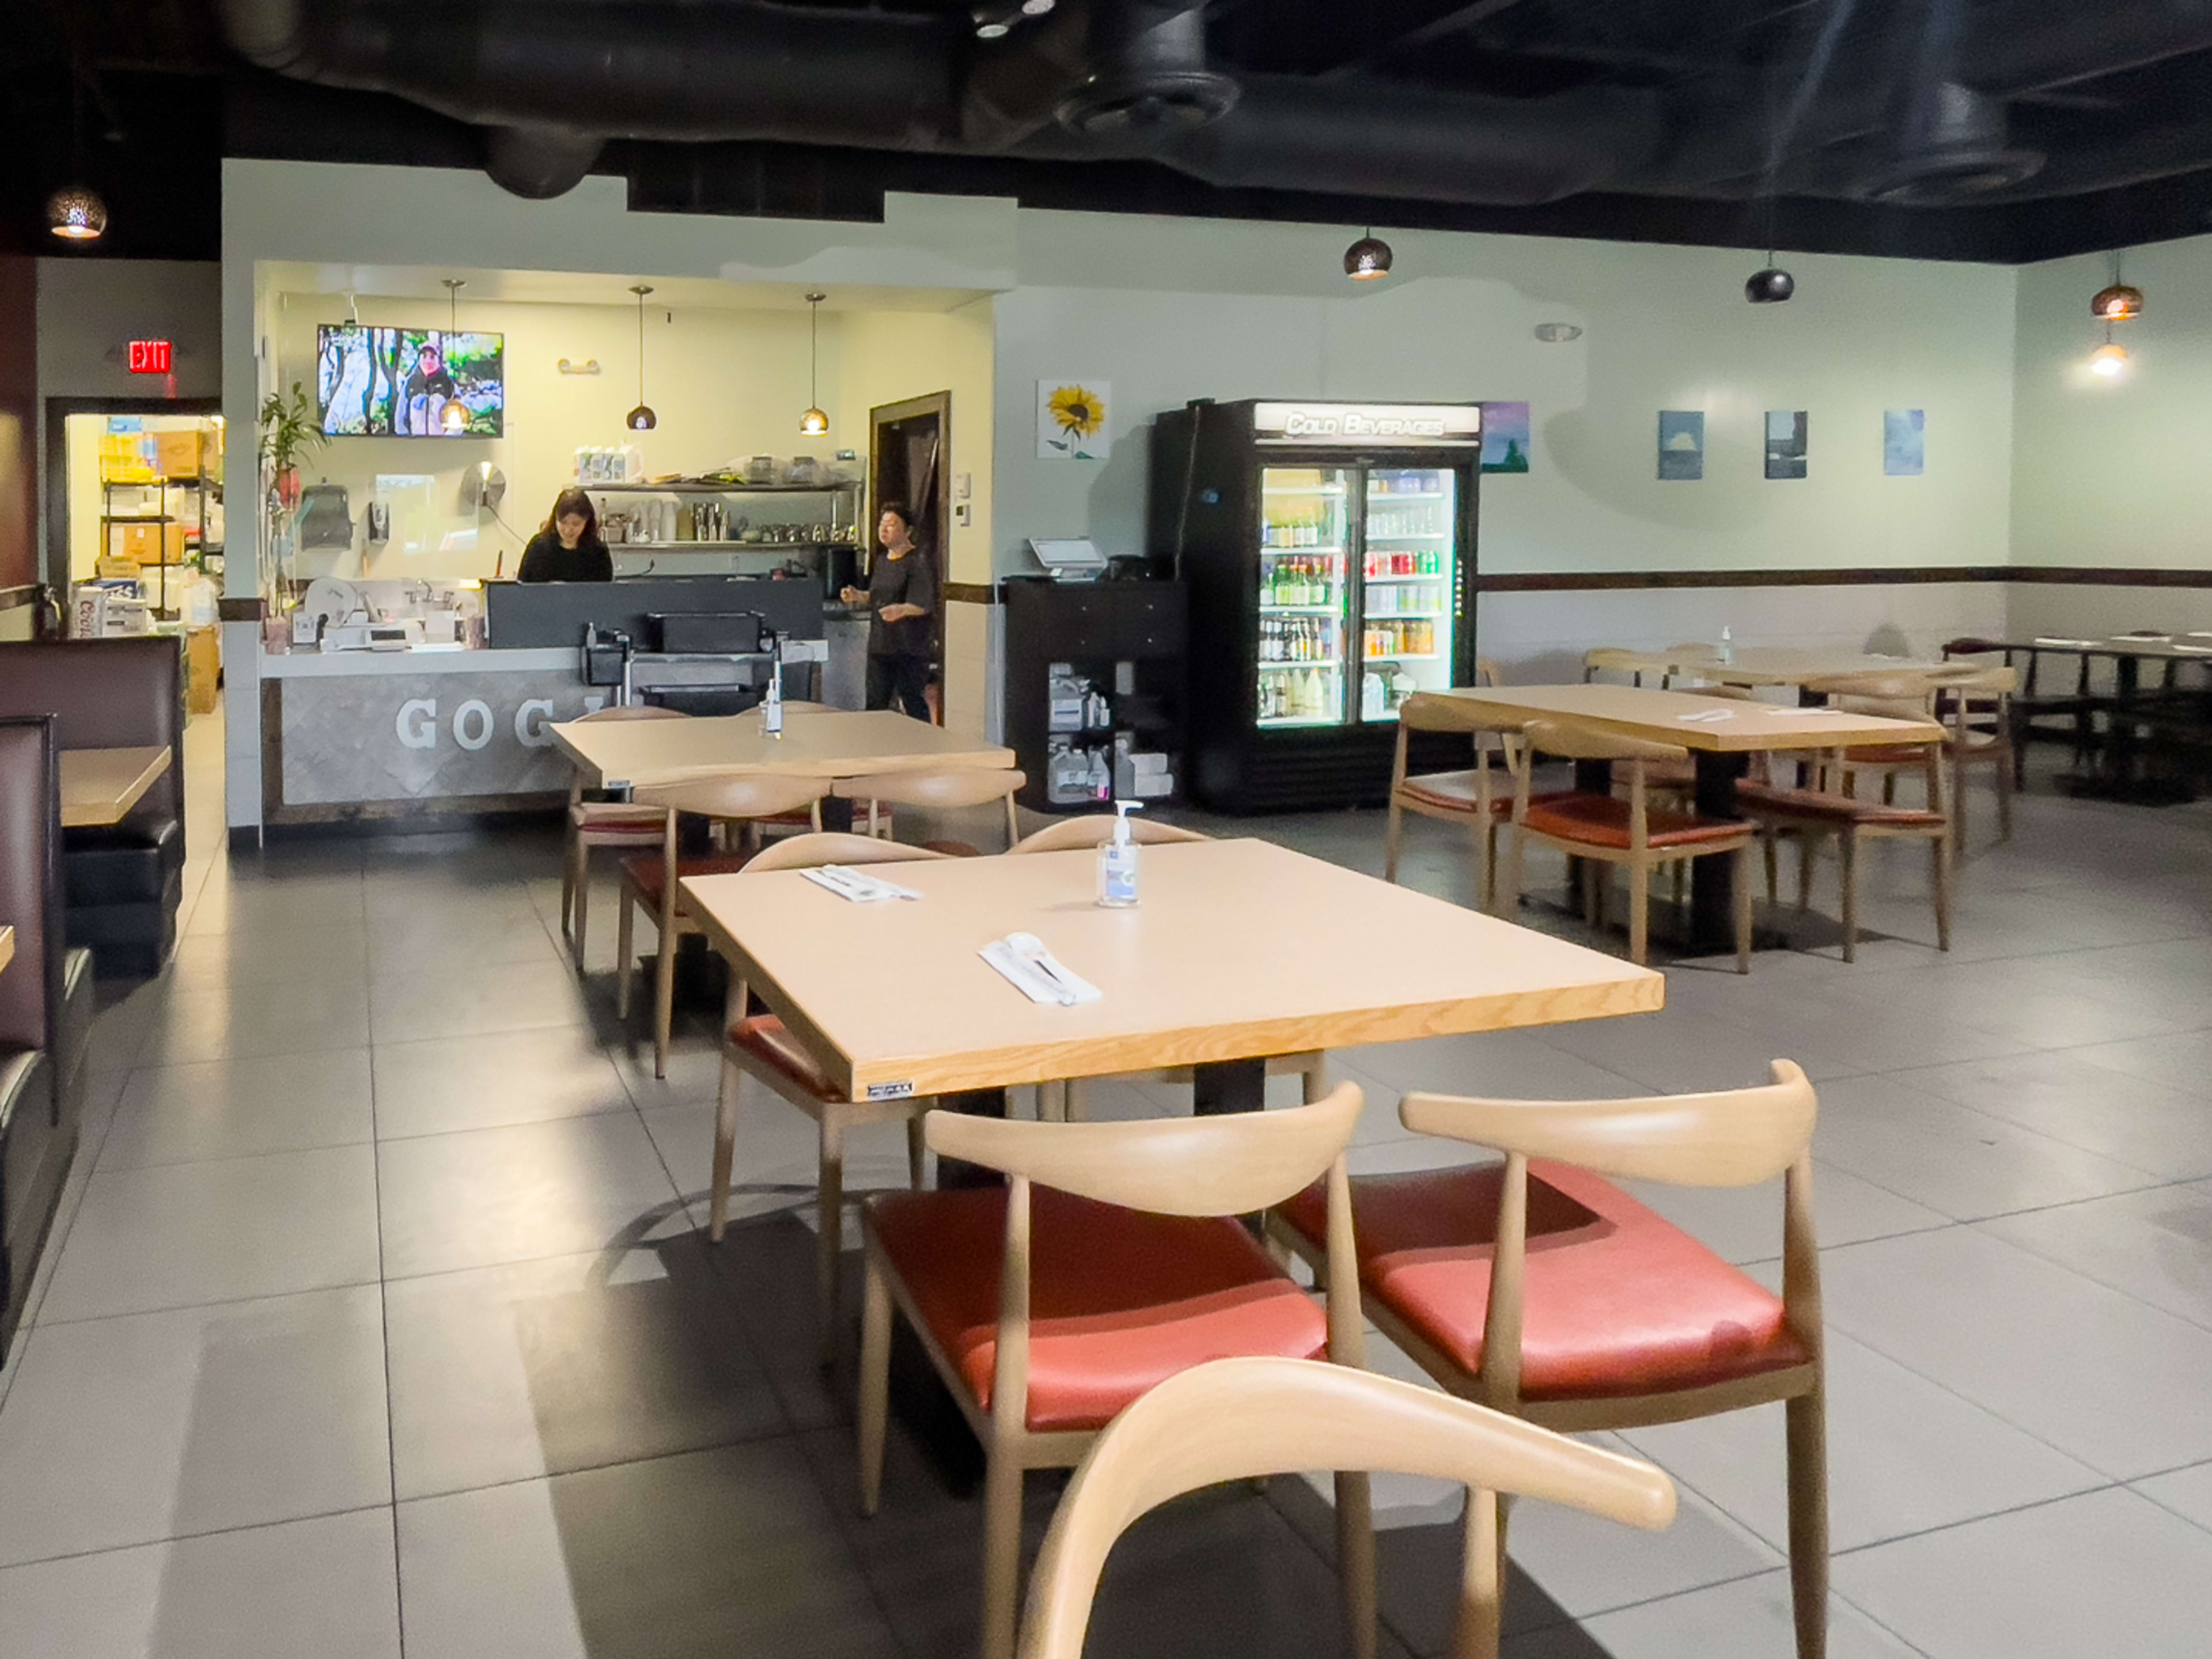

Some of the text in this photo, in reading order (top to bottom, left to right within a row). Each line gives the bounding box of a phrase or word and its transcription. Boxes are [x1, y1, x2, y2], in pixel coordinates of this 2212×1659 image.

[129, 341, 169, 369] EXIT
[1286, 412, 1446, 437] COLD BEVERAGES
